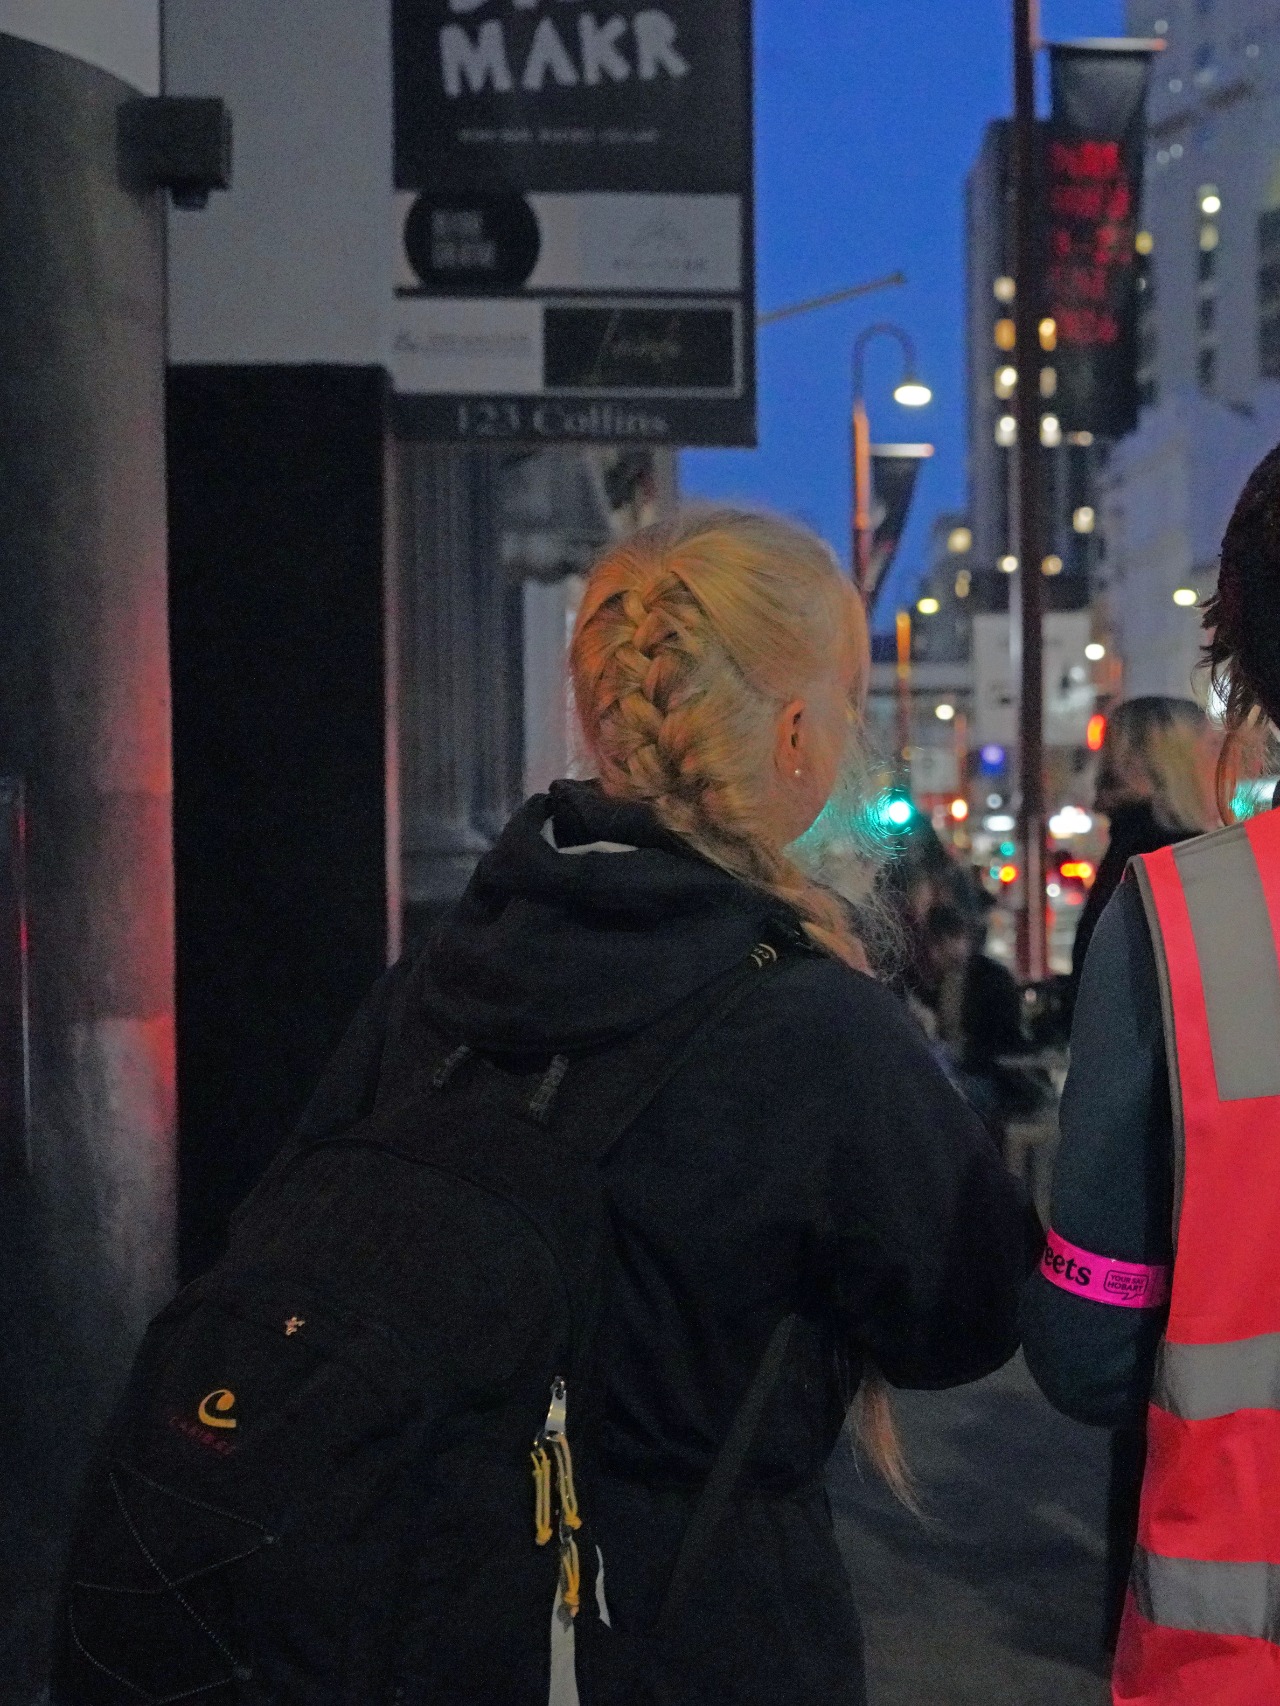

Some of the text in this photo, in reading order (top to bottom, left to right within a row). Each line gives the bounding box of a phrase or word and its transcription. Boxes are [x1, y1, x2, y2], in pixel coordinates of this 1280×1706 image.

[439, 10, 690, 96] MAKR
[532, 403, 669, 436] Collins
[1107, 1280, 1144, 1292] HOBART
[1111, 1274, 1145, 1285] YOUR SAY
